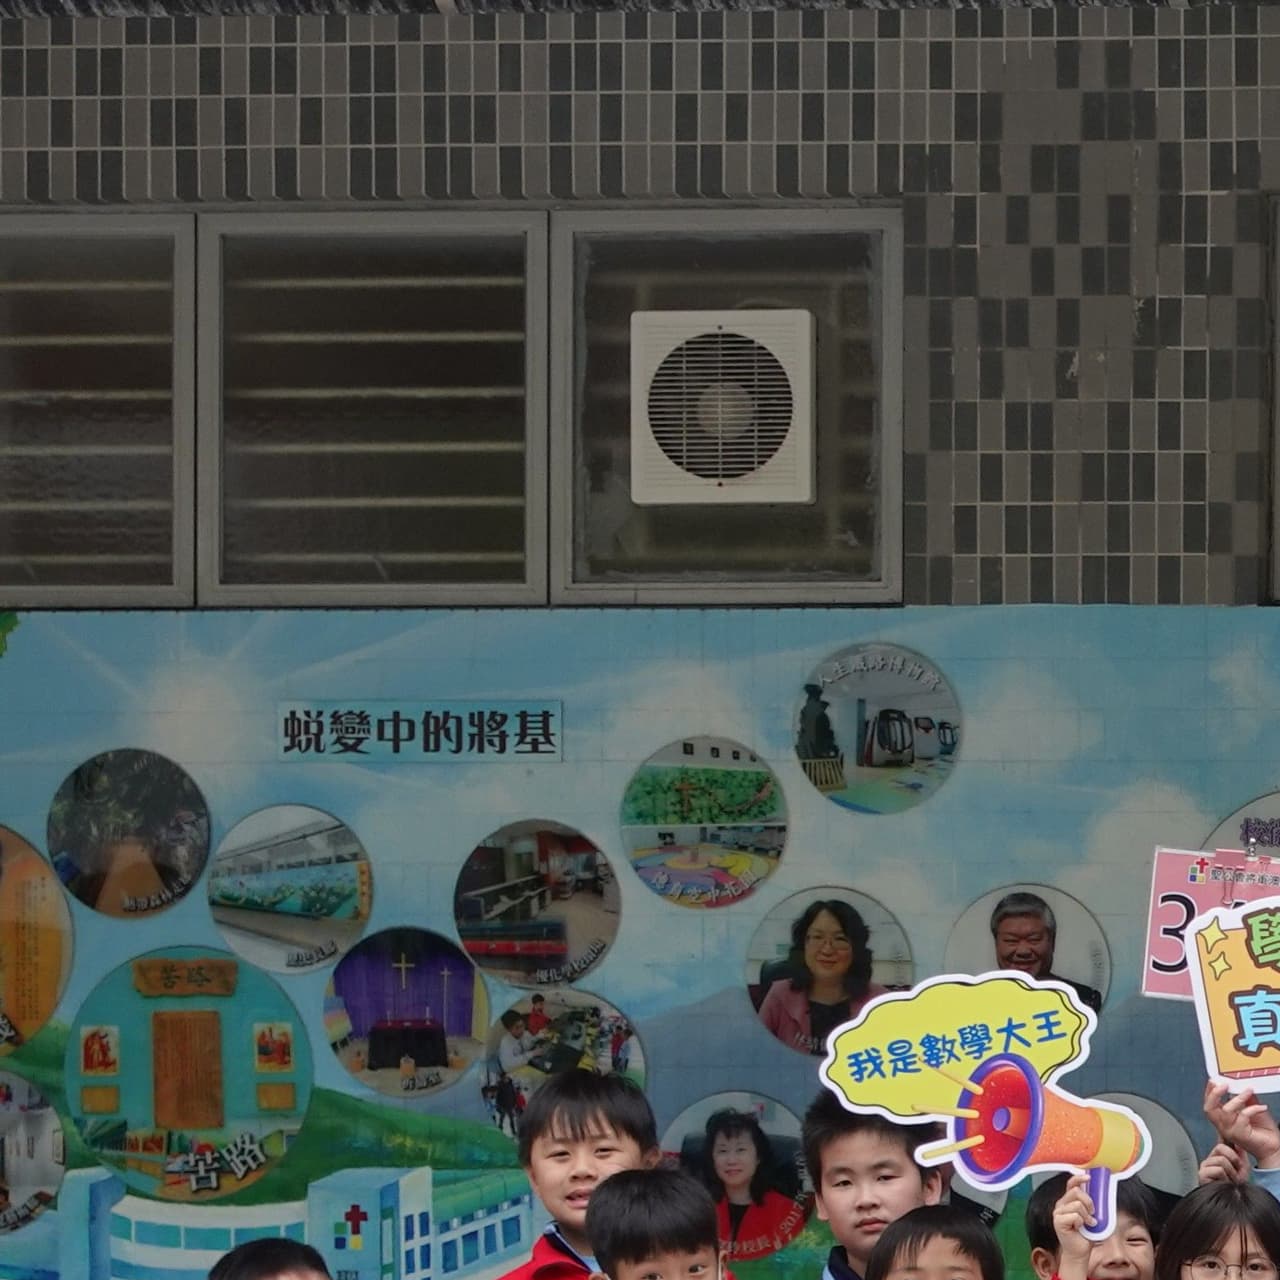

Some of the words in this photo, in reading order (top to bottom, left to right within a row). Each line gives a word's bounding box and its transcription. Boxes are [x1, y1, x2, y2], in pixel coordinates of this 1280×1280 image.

[847, 1009, 1068, 1084] 我是數學大王
[184, 1134, 266, 1192] 苦路
